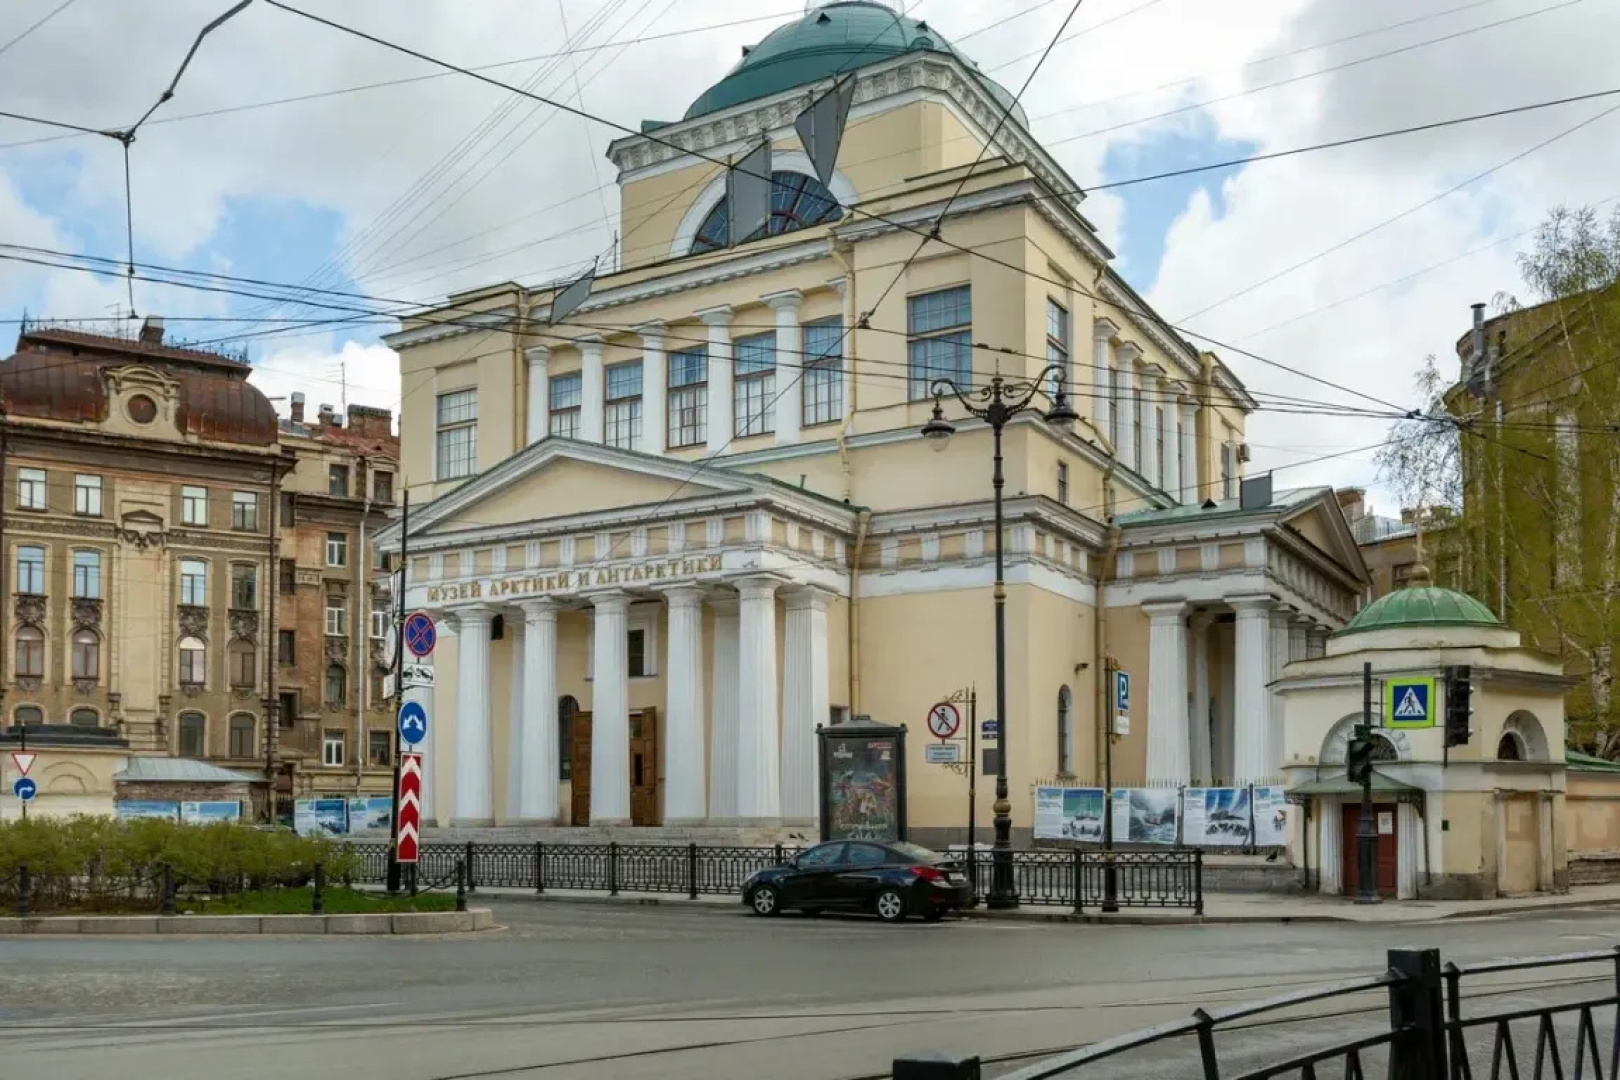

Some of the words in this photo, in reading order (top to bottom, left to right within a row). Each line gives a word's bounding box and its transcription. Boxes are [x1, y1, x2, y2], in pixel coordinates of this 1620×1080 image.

[427, 579, 481, 601] МУЗЕЙ
[489, 570, 569, 597] АРКТИКИ
[578, 571, 590, 586] И
[596, 554, 721, 585] АНТАРКТИКИ
